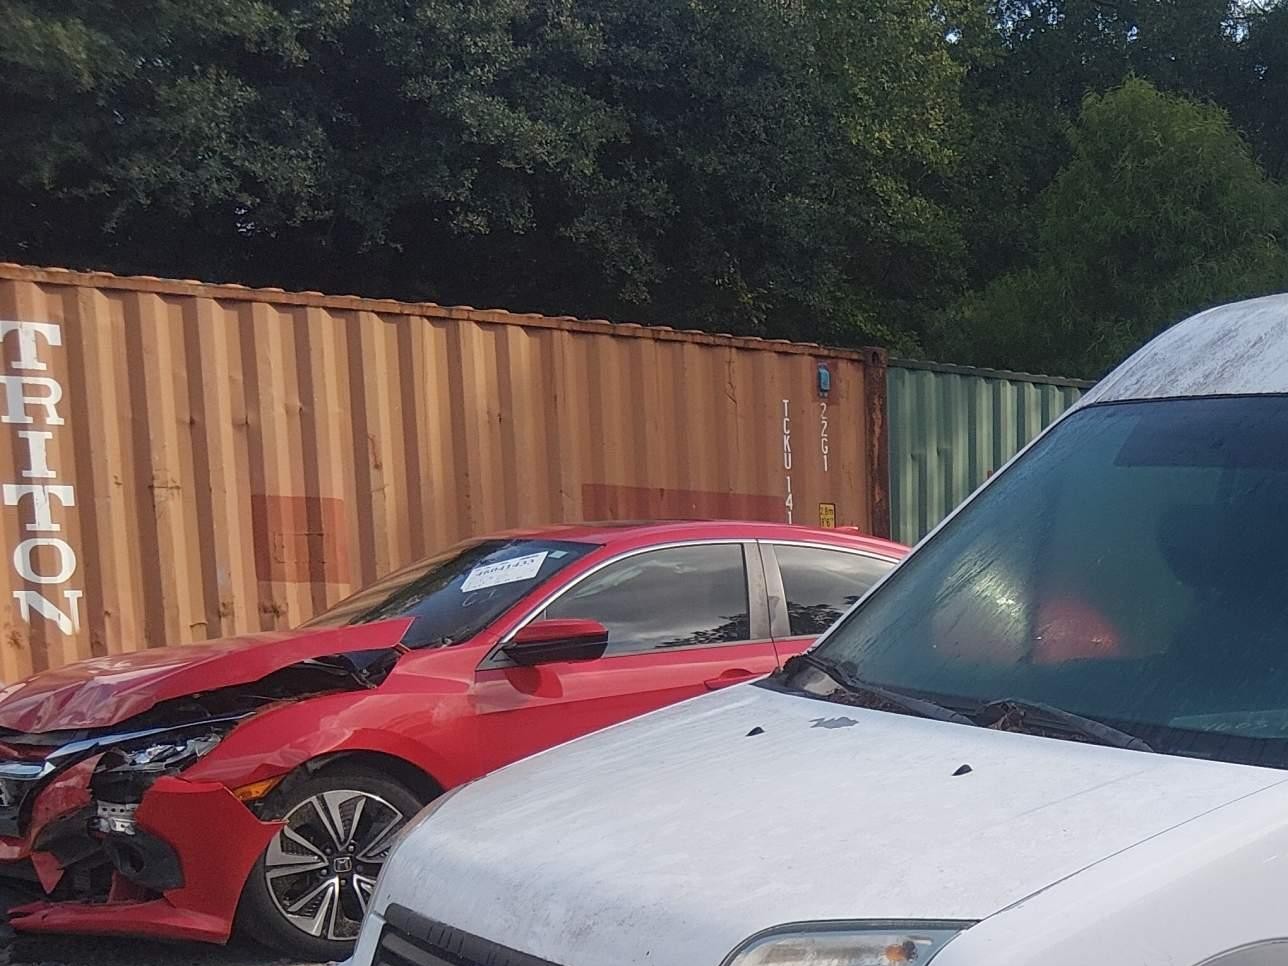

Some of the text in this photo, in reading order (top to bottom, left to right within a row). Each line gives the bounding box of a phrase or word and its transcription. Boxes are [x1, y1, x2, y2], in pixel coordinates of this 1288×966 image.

[0, 321, 82, 636] TRITON
[782, 399, 793, 525] TCKU 141
[820, 402, 829, 472] 22G1
